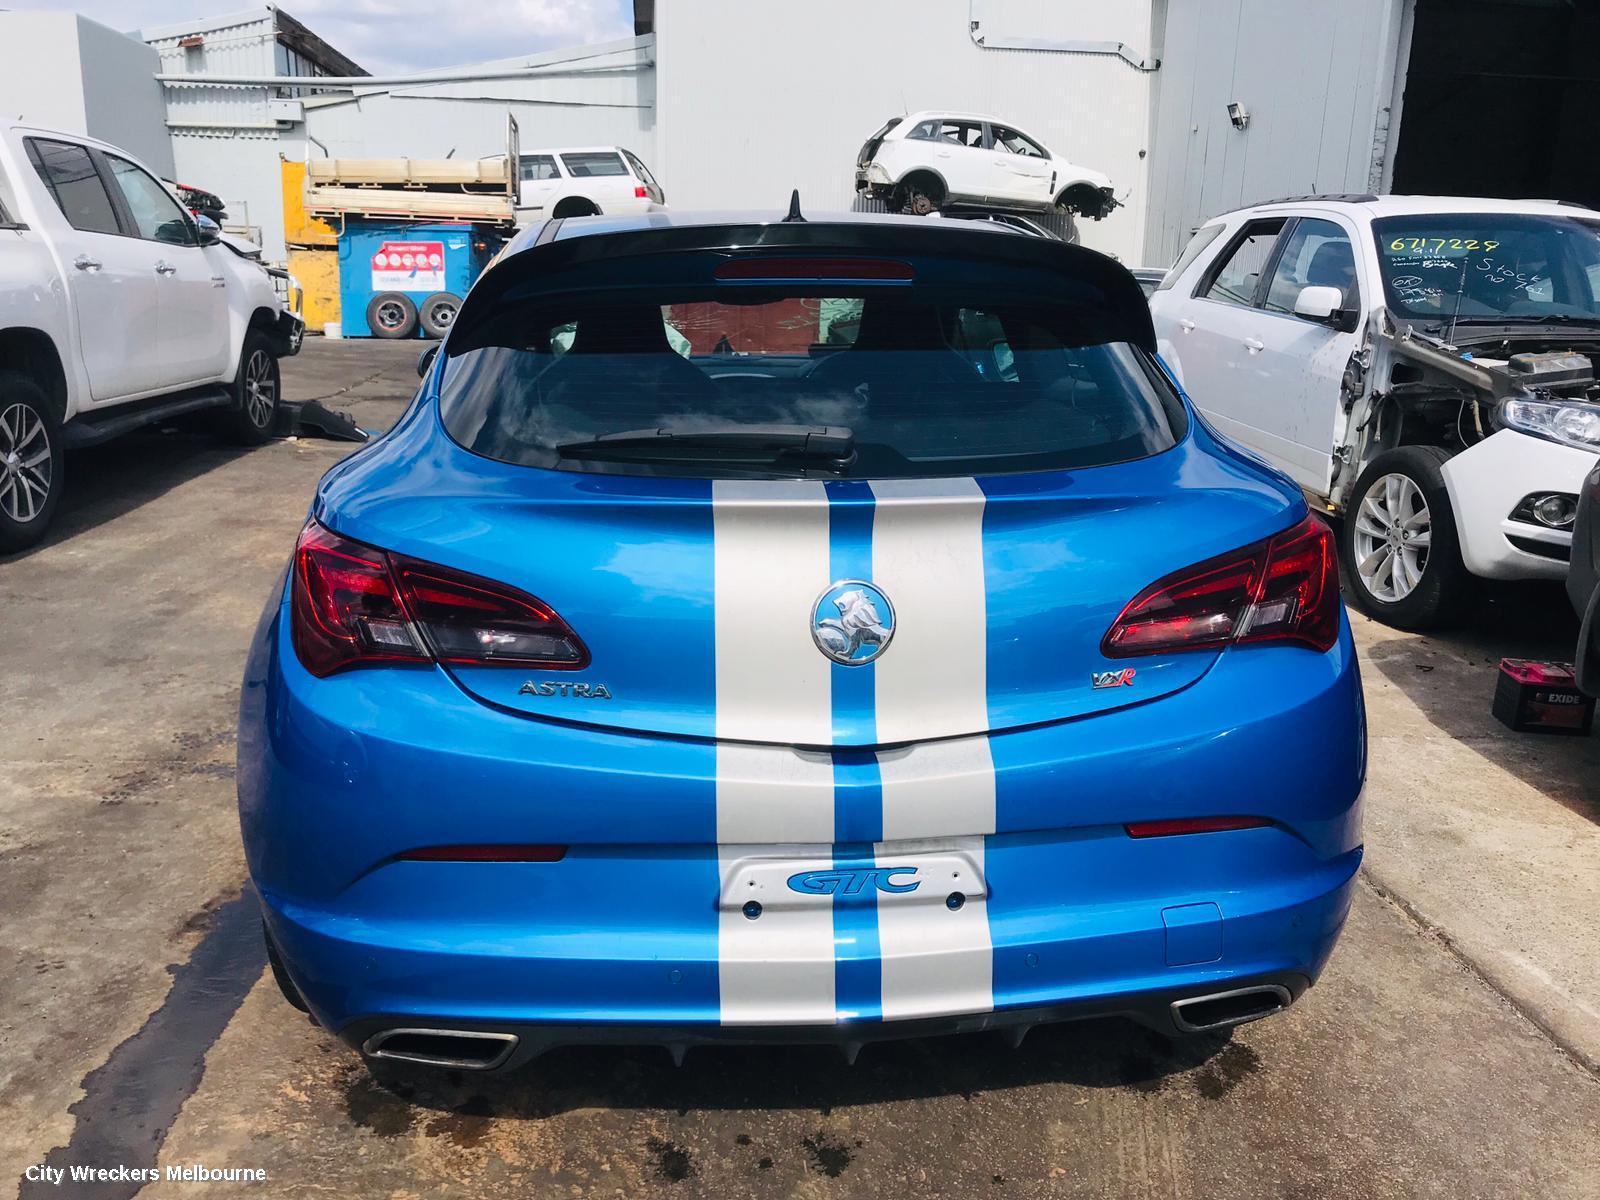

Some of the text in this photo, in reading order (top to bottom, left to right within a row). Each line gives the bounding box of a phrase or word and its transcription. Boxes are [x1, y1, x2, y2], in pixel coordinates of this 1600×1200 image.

[1091, 667, 1136, 689] VXR
[518, 680, 612, 700] ASTRA
[1548, 693, 1580, 704] EXIDE
[787, 866, 922, 895] GTC
